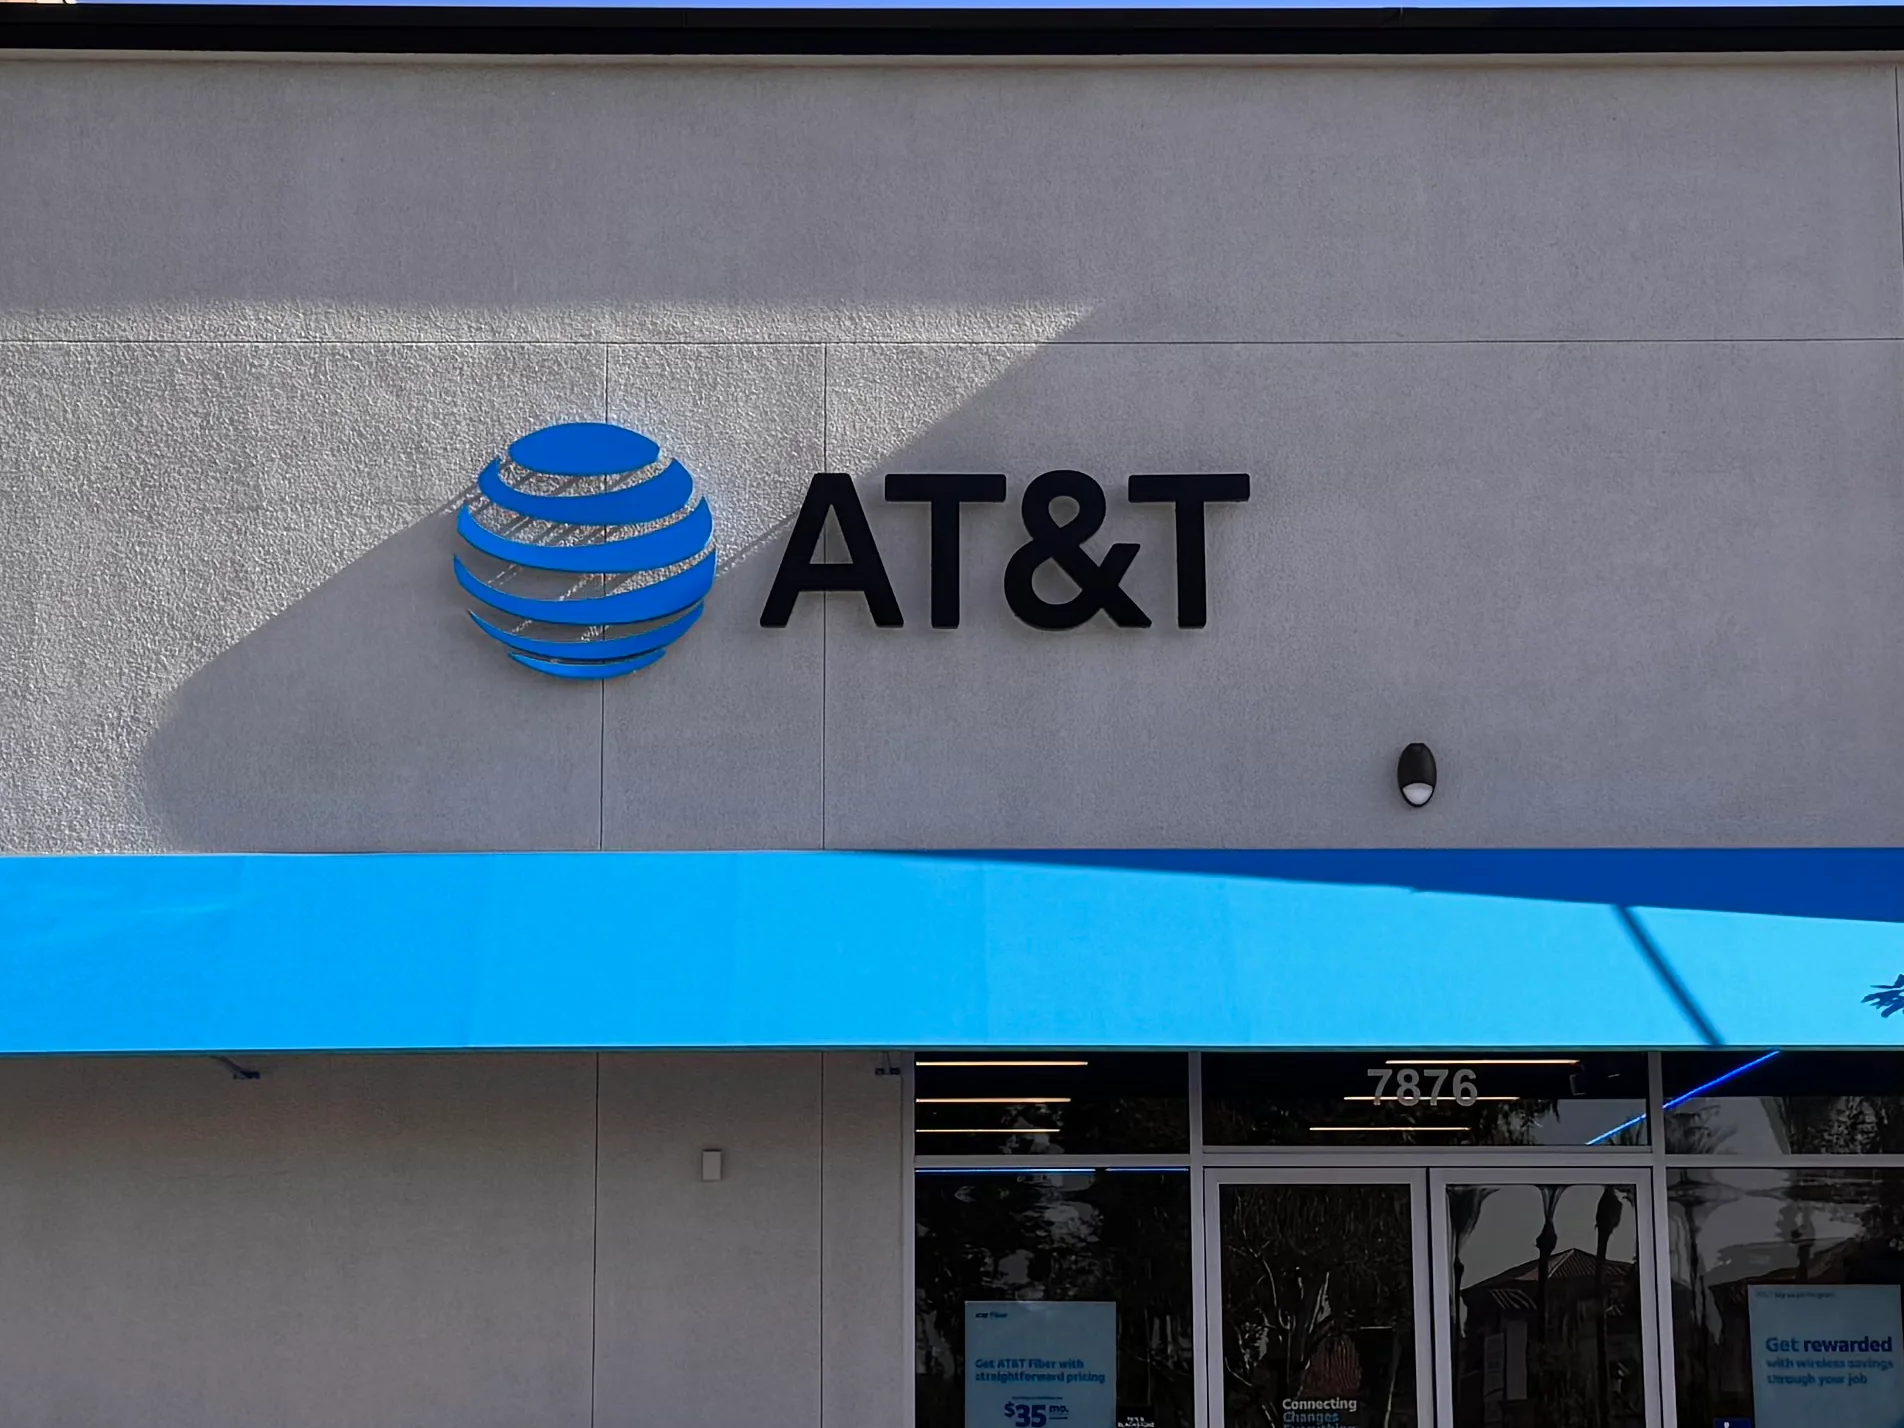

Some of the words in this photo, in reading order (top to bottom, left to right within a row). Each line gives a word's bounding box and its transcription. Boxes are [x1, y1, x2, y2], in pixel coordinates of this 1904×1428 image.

[760, 468, 1251, 630] AT&T
[1367, 1068, 1478, 1107] 7876
[1765, 1336, 1800, 1353] Get
[1803, 1335, 1893, 1353] rewarded
[1003, 1401, 1047, 1428] $35
[1282, 1397, 1358, 1413] Connecting
[1282, 1411, 1340, 1425] Changes
